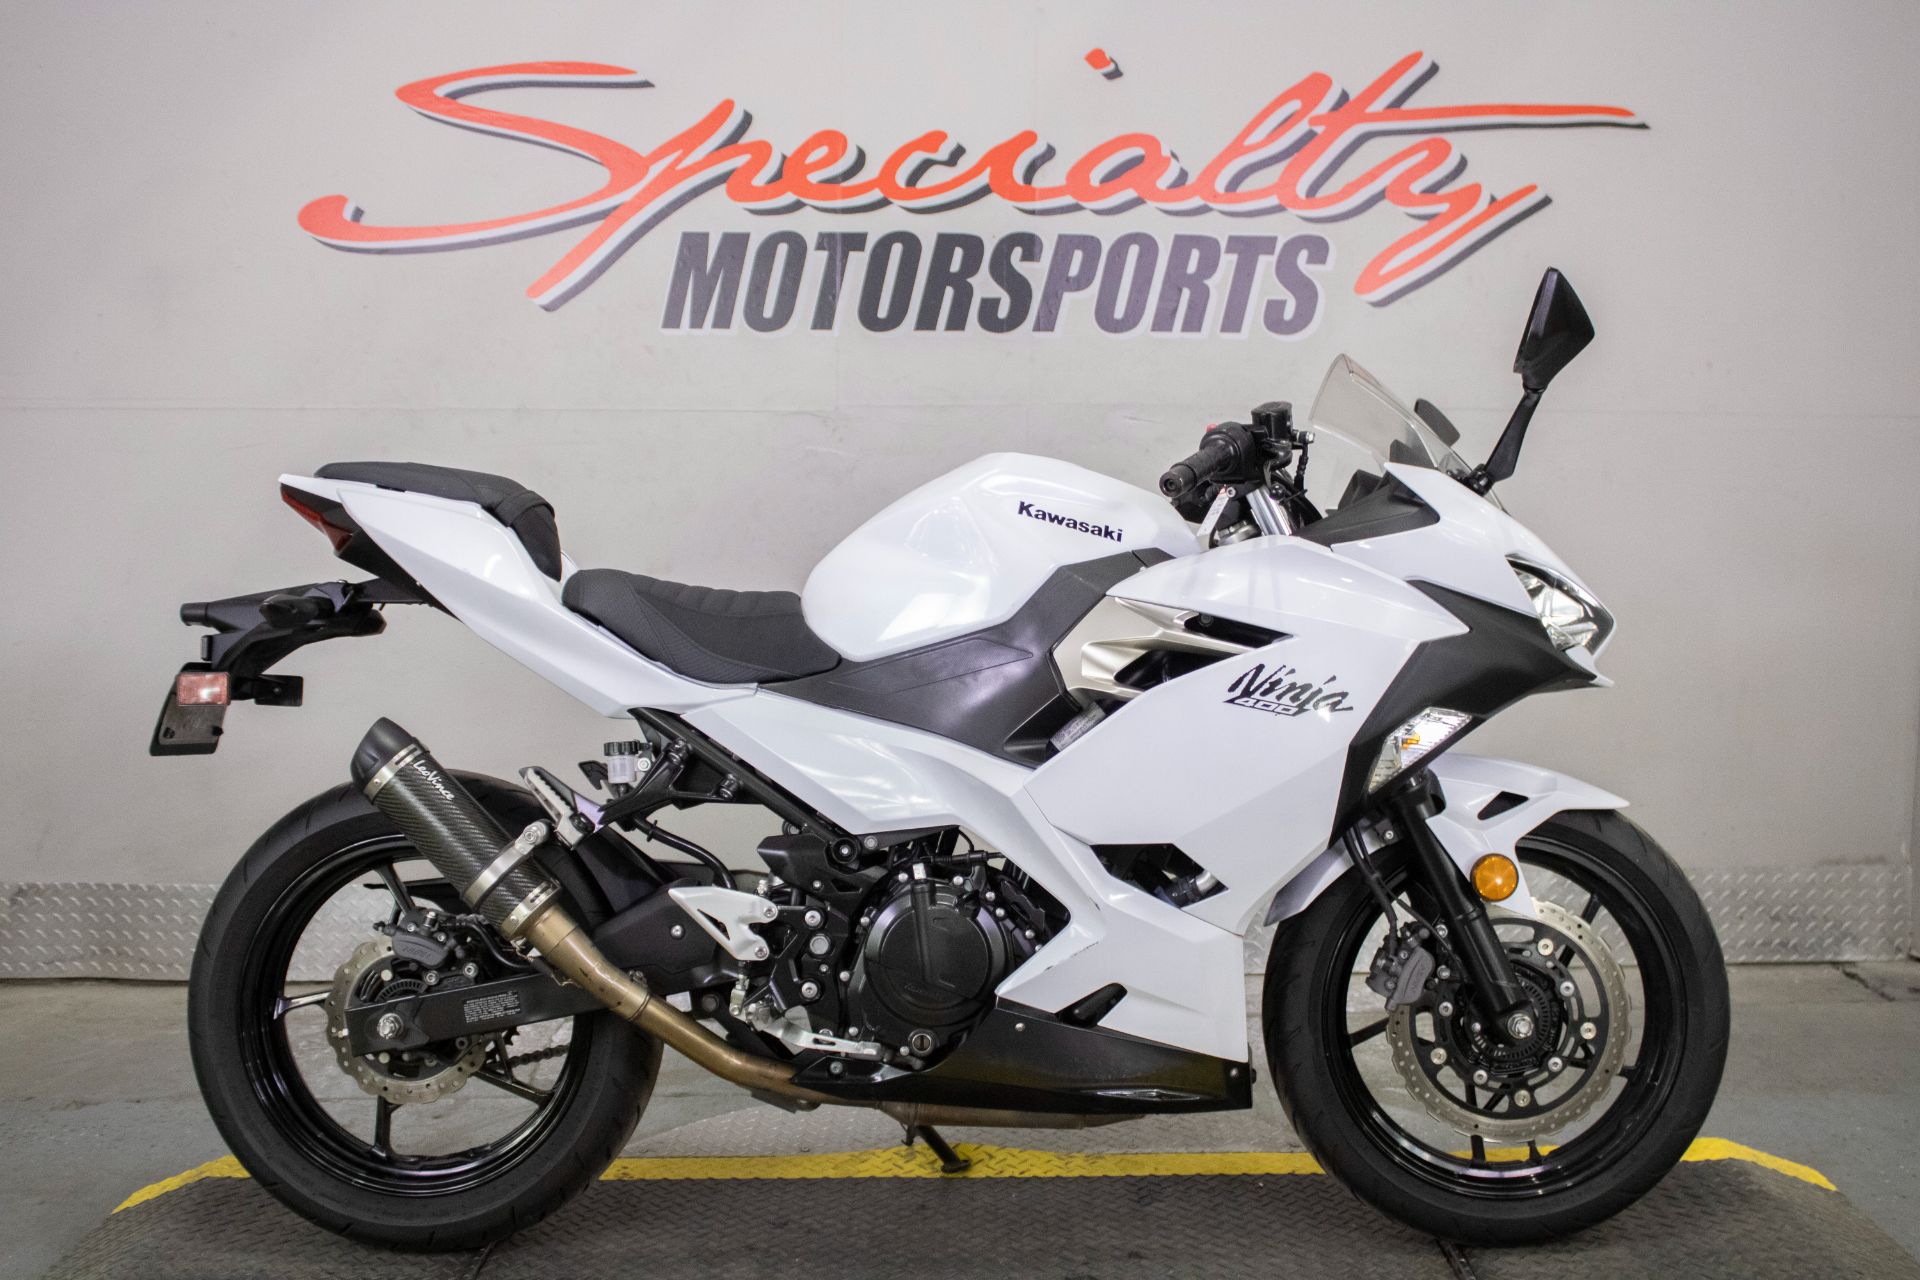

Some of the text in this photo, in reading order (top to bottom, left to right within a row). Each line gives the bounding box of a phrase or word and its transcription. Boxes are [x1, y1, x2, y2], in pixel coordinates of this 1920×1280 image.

[298, 49, 1650, 309] Specialty
[661, 231, 1330, 332] MOTORSPORTS
[1018, 501, 1123, 543] Kawasaki
[1226, 663, 1354, 714] Ninja
[1233, 697, 1299, 715] 400
[413, 759, 455, 801] LeoVince
